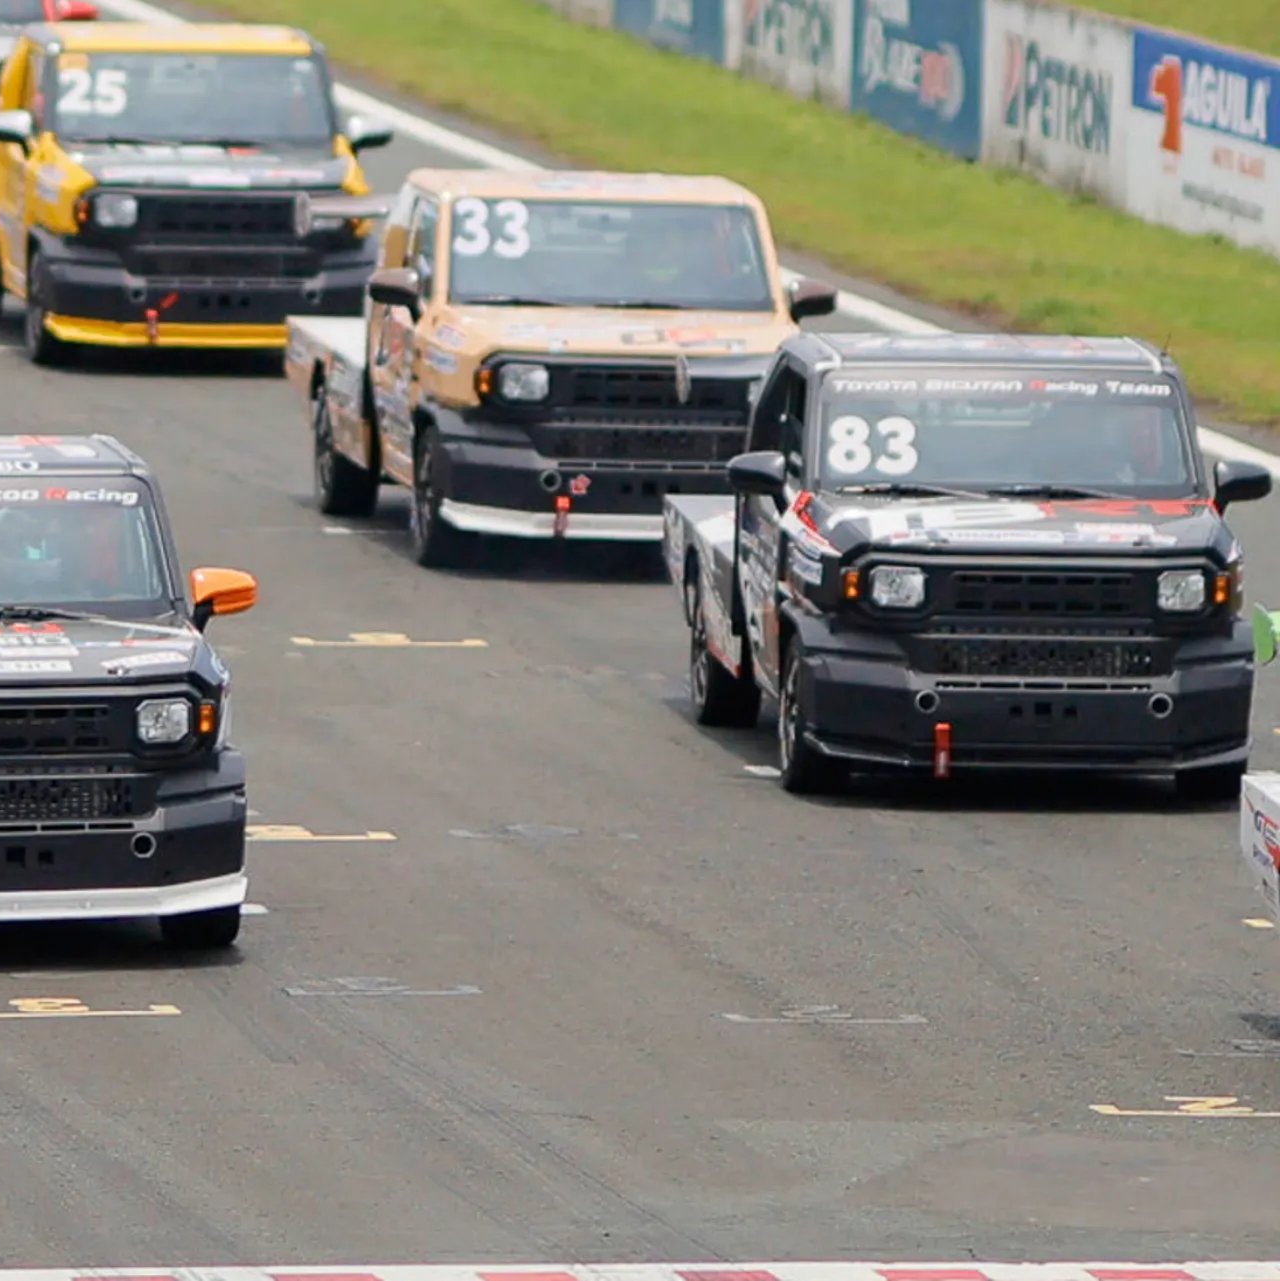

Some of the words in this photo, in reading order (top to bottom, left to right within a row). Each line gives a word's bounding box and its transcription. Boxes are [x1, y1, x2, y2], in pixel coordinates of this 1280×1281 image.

[56, 68, 128, 117] 25
[1023, 40, 1113, 157] PETRON
[1184, 60, 1268, 142] AGUILA
[452, 197, 531, 259] 33
[831, 378, 918, 394] TOYOTA
[1028, 378, 1098, 397] Racing
[1104, 380, 1172, 397] TEAM
[827, 414, 919, 476] 83
[45, 487, 139, 507] Racing
